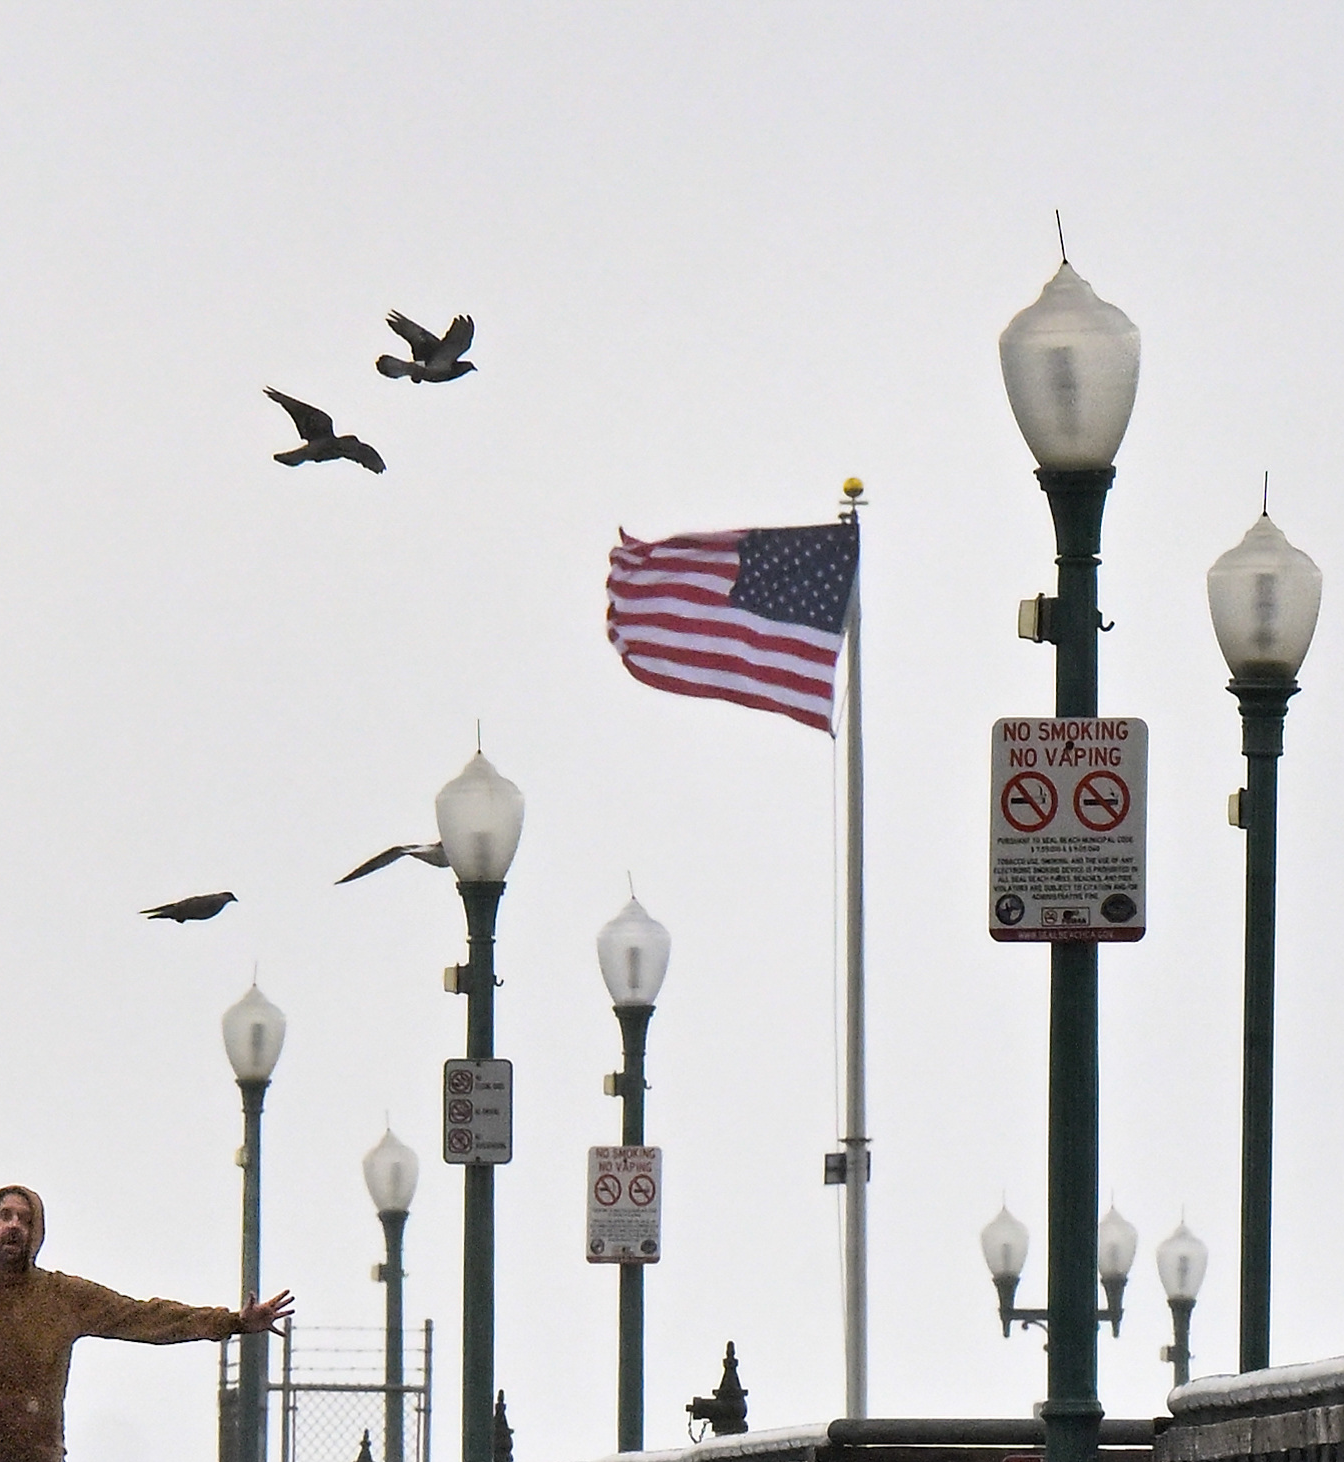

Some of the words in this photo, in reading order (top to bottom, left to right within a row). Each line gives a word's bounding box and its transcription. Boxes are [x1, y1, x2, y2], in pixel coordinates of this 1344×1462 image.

[1003, 722, 1031, 741] NO
[1038, 721, 1129, 741] SMOKING
[1009, 748, 1037, 767] NO
[1045, 747, 1122, 767] VAPING
[596, 1149, 610, 1158] NO
[613, 1148, 655, 1159] SMOKING
[599, 1162, 613, 1172] NO
[616, 1162, 652, 1173] VAPING
